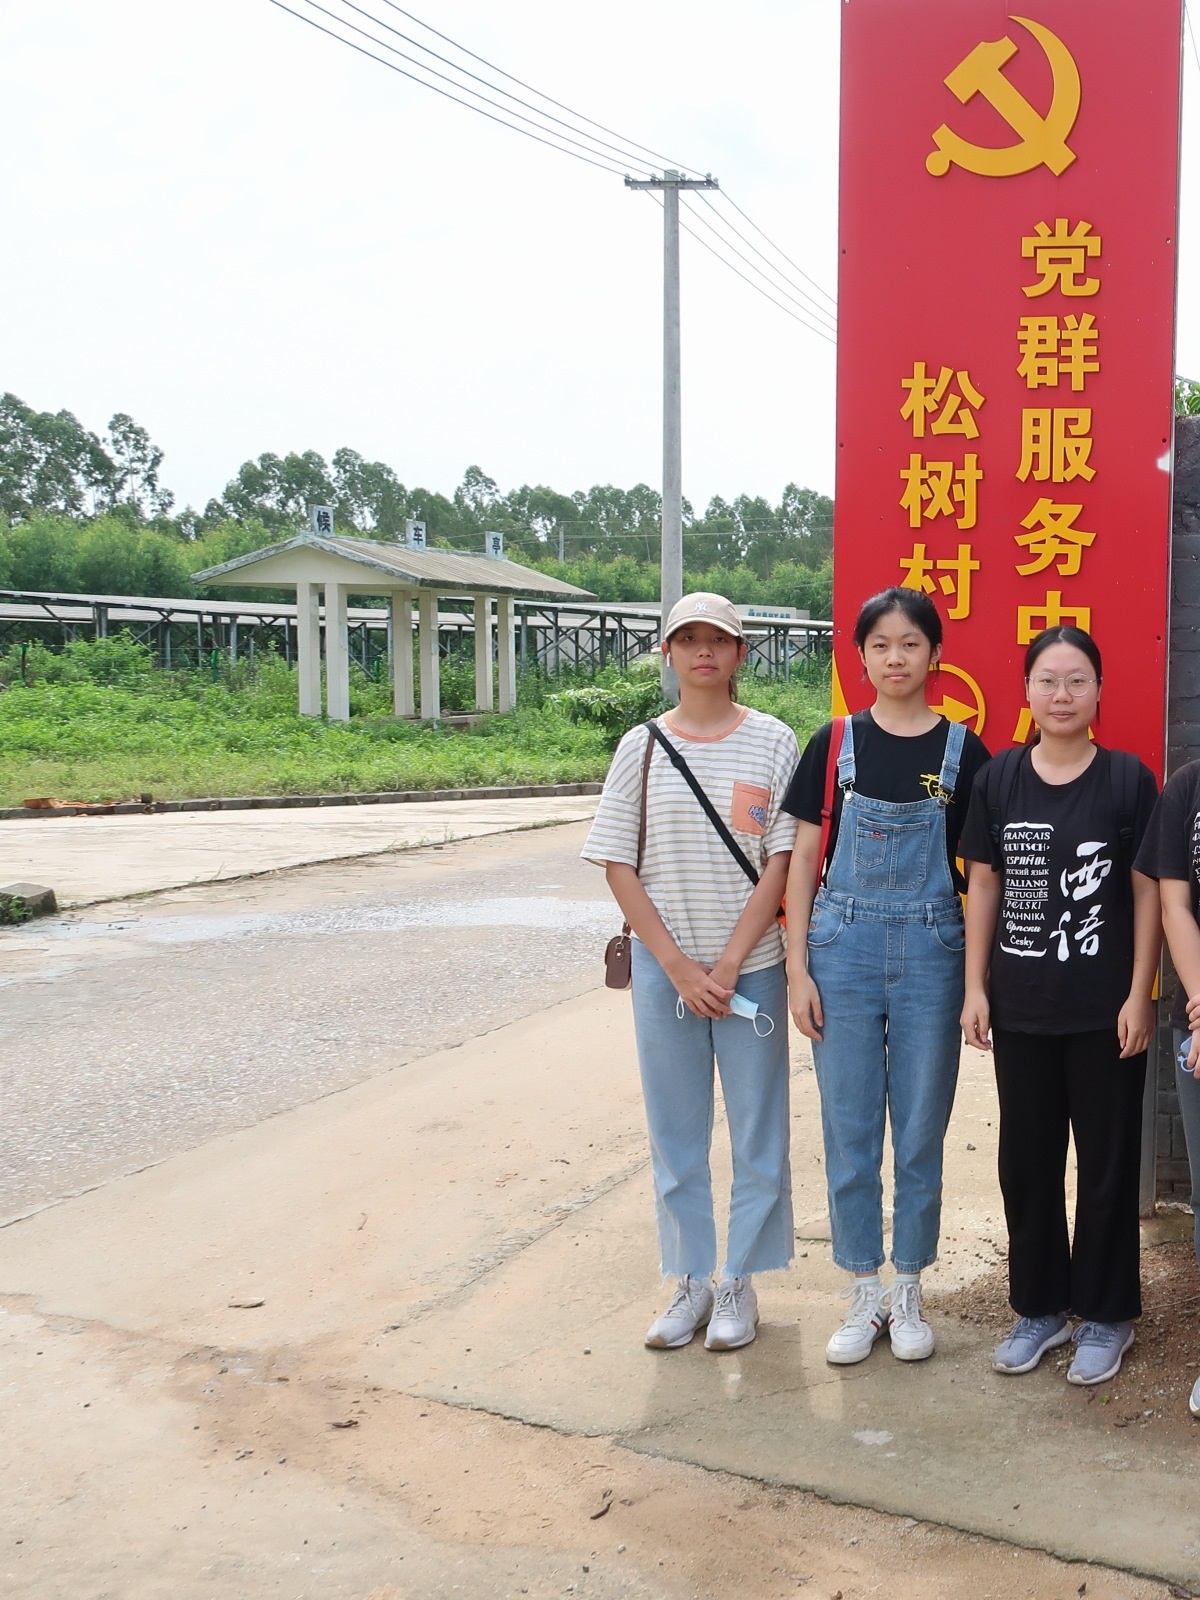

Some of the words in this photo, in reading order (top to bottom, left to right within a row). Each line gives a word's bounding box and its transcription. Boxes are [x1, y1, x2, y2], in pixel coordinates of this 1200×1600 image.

[898, 361, 986, 620] 松树村
[1012, 218, 1103, 744] 党群服务中
